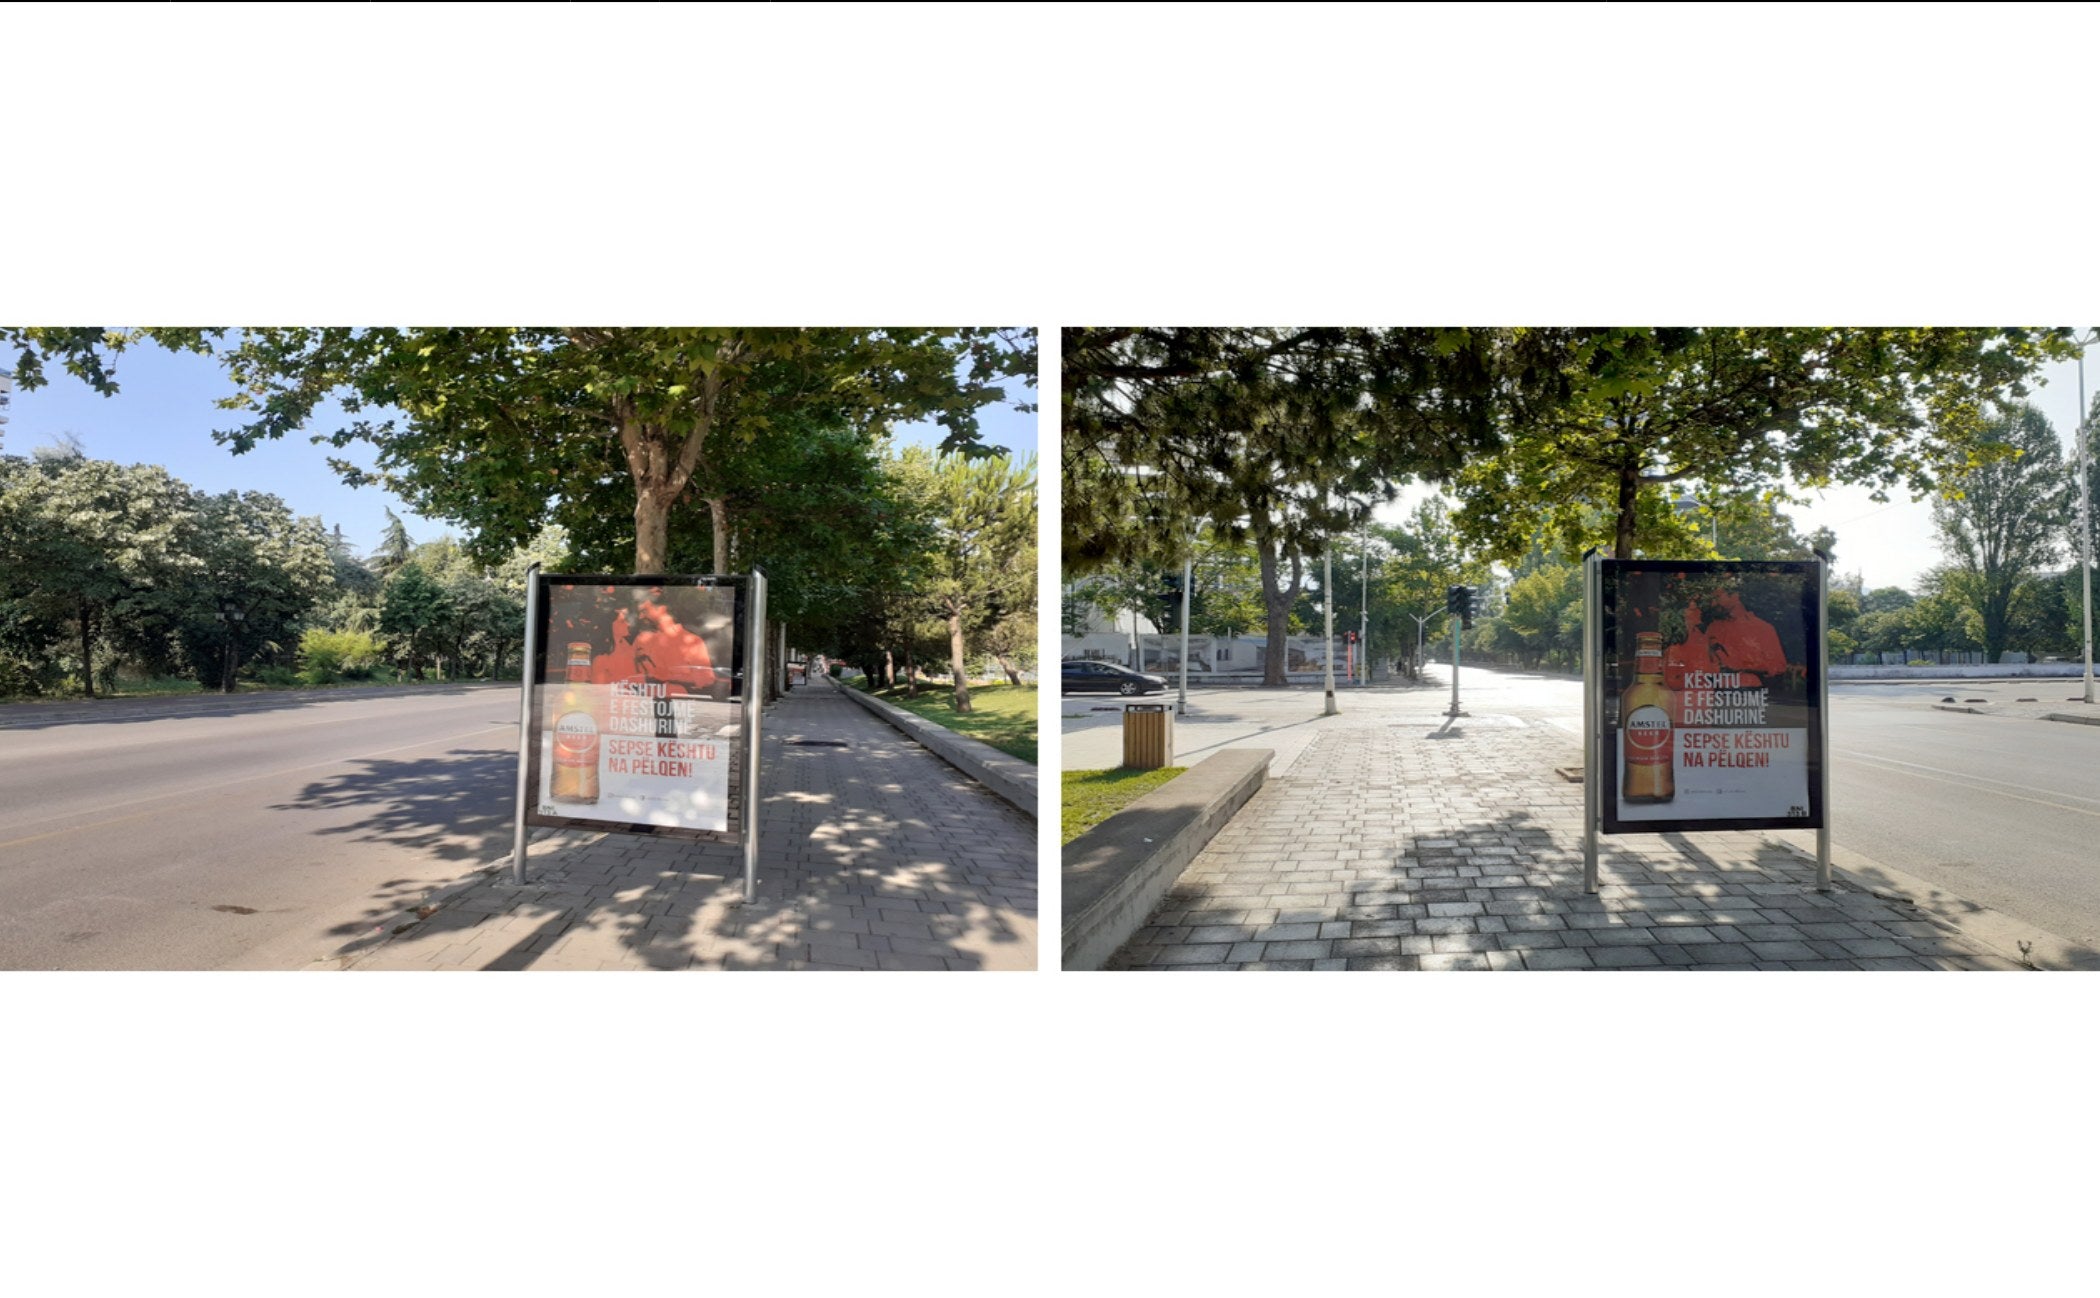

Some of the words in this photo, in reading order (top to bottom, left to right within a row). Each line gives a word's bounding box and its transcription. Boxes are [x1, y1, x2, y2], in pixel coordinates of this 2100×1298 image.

[1684, 669, 1740, 688] KËSHTU
[1684, 690, 1693, 706] E
[1697, 687, 1769, 707] FESTOJMË
[610, 699, 618, 715] E
[1684, 706, 1767, 725] DASHURINË
[1683, 732, 1730, 749] SEPSE
[1734, 730, 1790, 749] KËSHTU
[608, 739, 653, 756] SEPSE
[657, 739, 716, 760] KËSHTU
[1683, 752, 1704, 768] NA
[1708, 749, 1770, 769] PËLQEN!
[608, 757, 628, 774] NA
[632, 756, 693, 778] PËLQEN!
